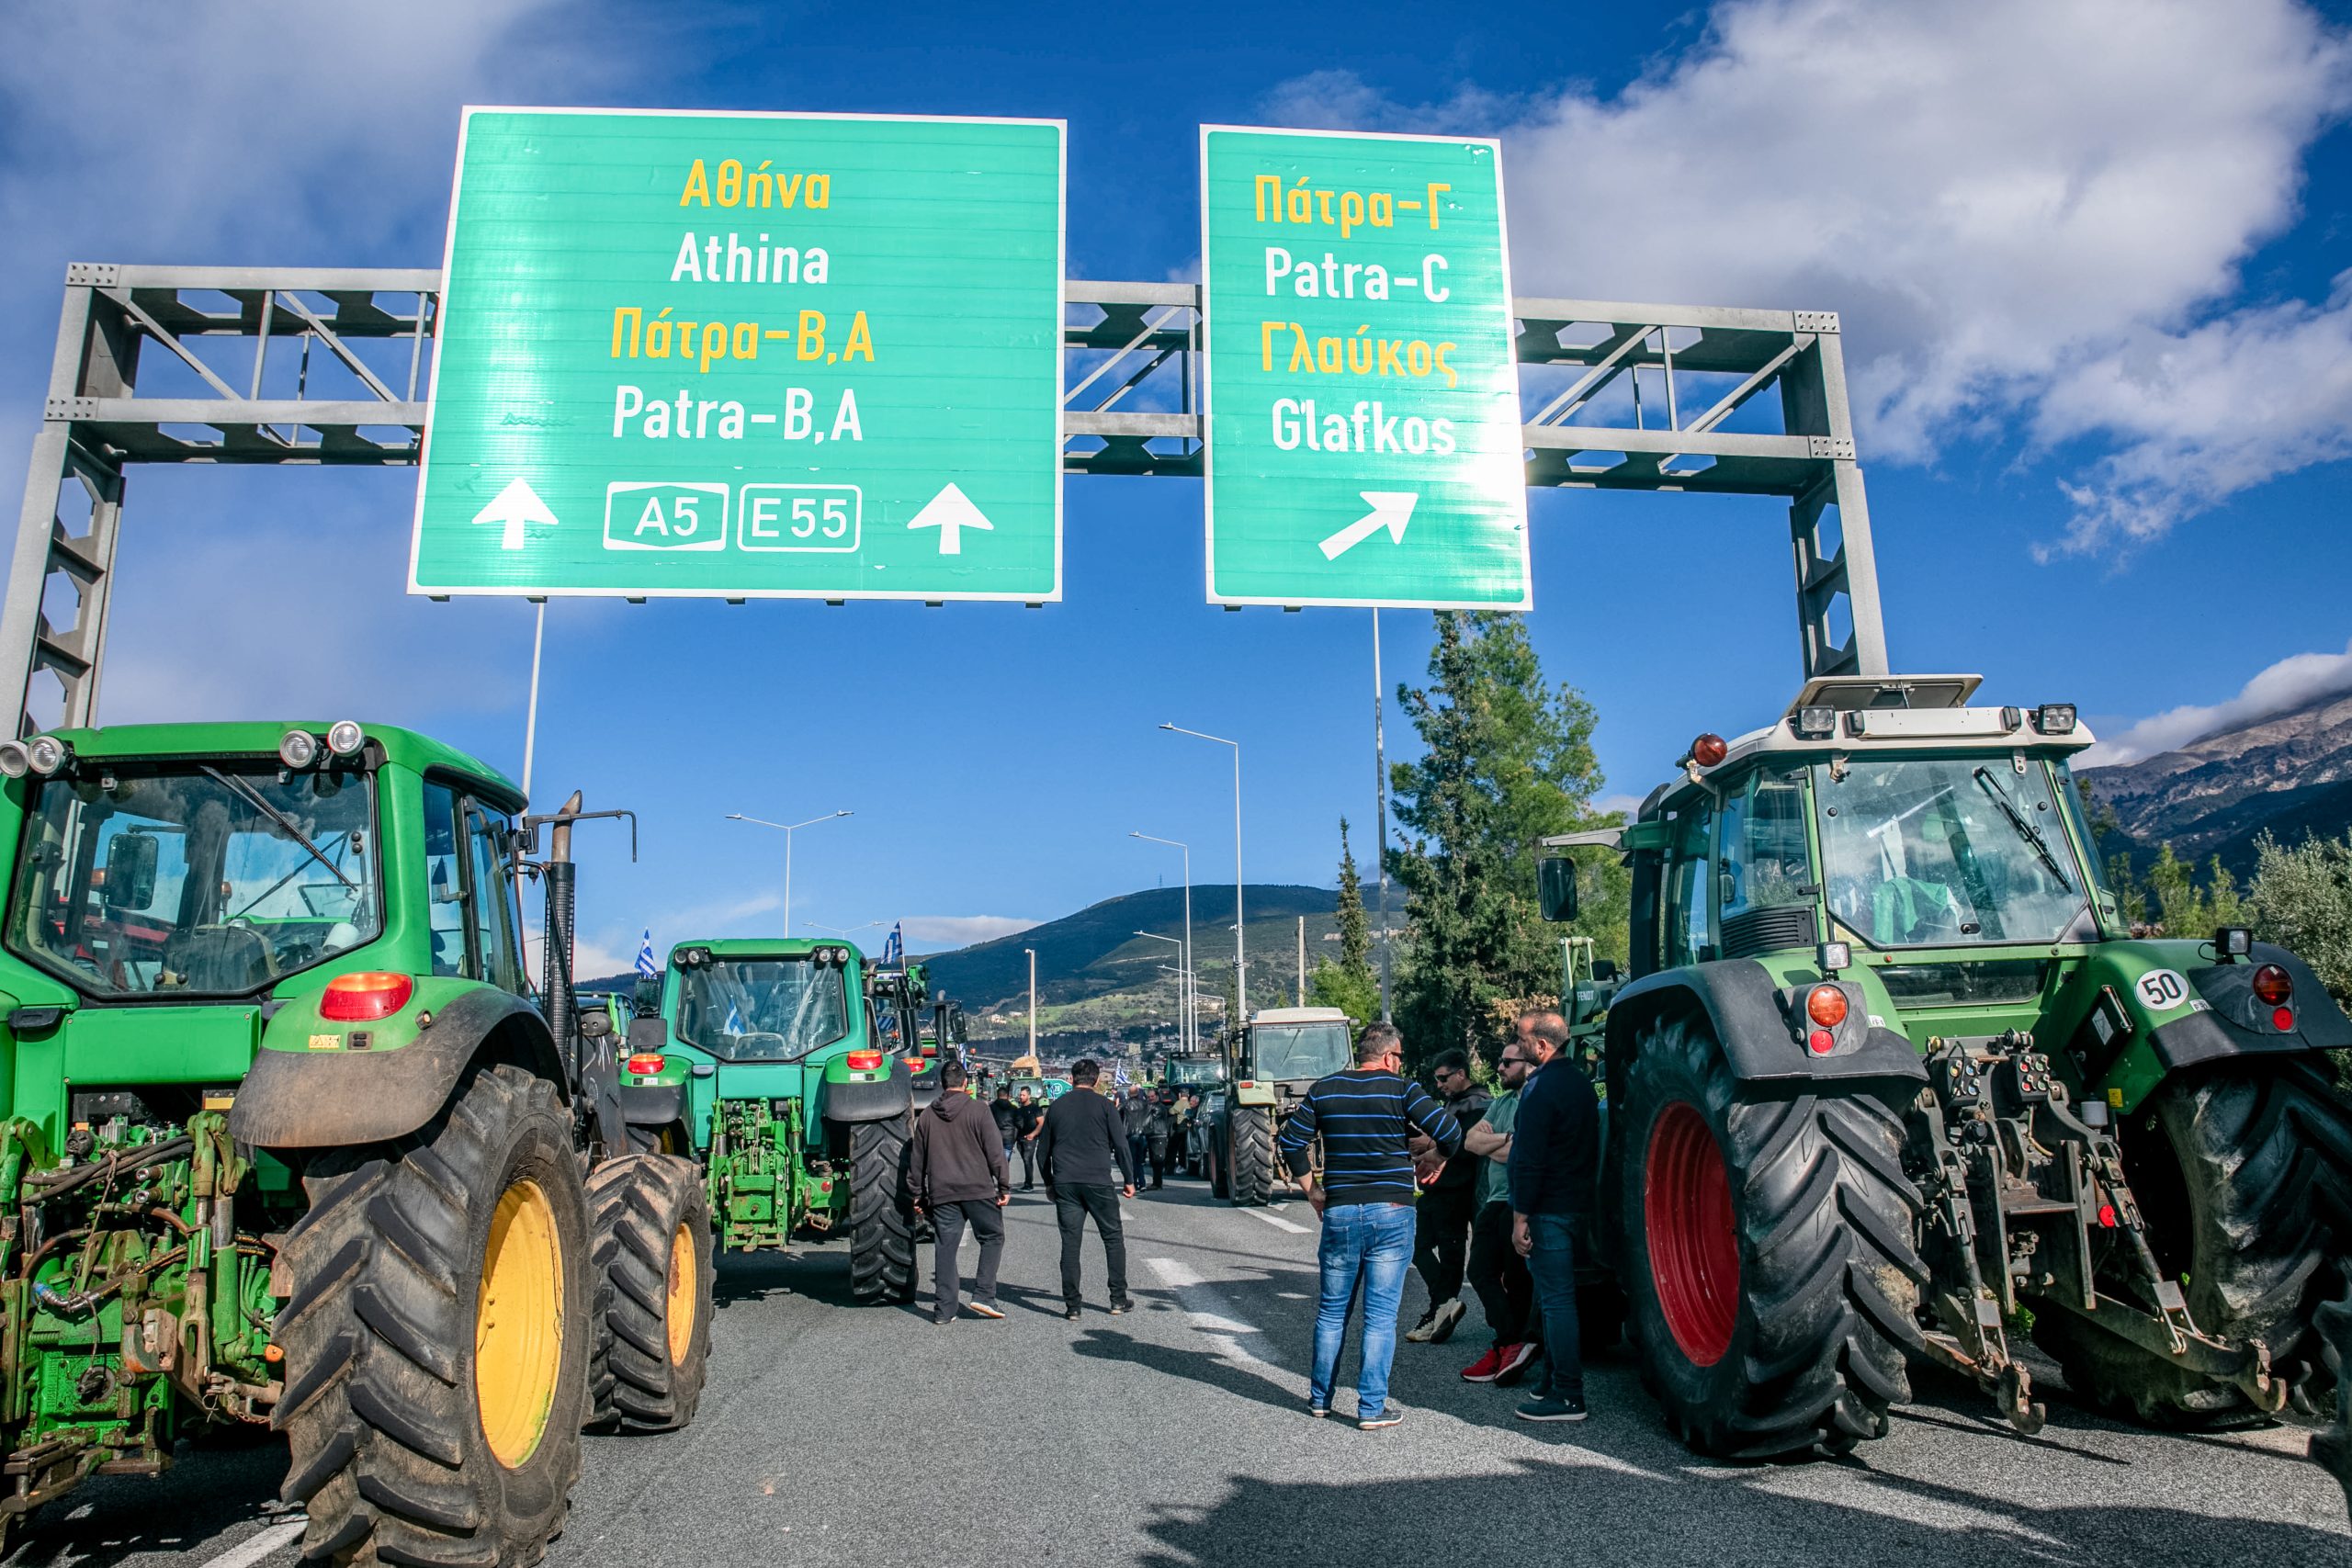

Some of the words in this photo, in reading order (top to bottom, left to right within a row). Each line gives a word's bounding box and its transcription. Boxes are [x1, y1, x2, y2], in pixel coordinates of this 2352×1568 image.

[680, 159, 830, 209] Αθήνα
[1255, 175, 1452, 239] Πάτρα-Γ
[671, 232, 829, 284] Athina
[1265, 247, 1450, 302] Patra-C
[1261, 321, 1458, 389] Γλαύκος
[1272, 398, 1456, 456] Glafkos
[634, 497, 698, 536] A5
[1577, 990, 1594, 1001] FENDT
[2142, 974, 2181, 1004] 50
